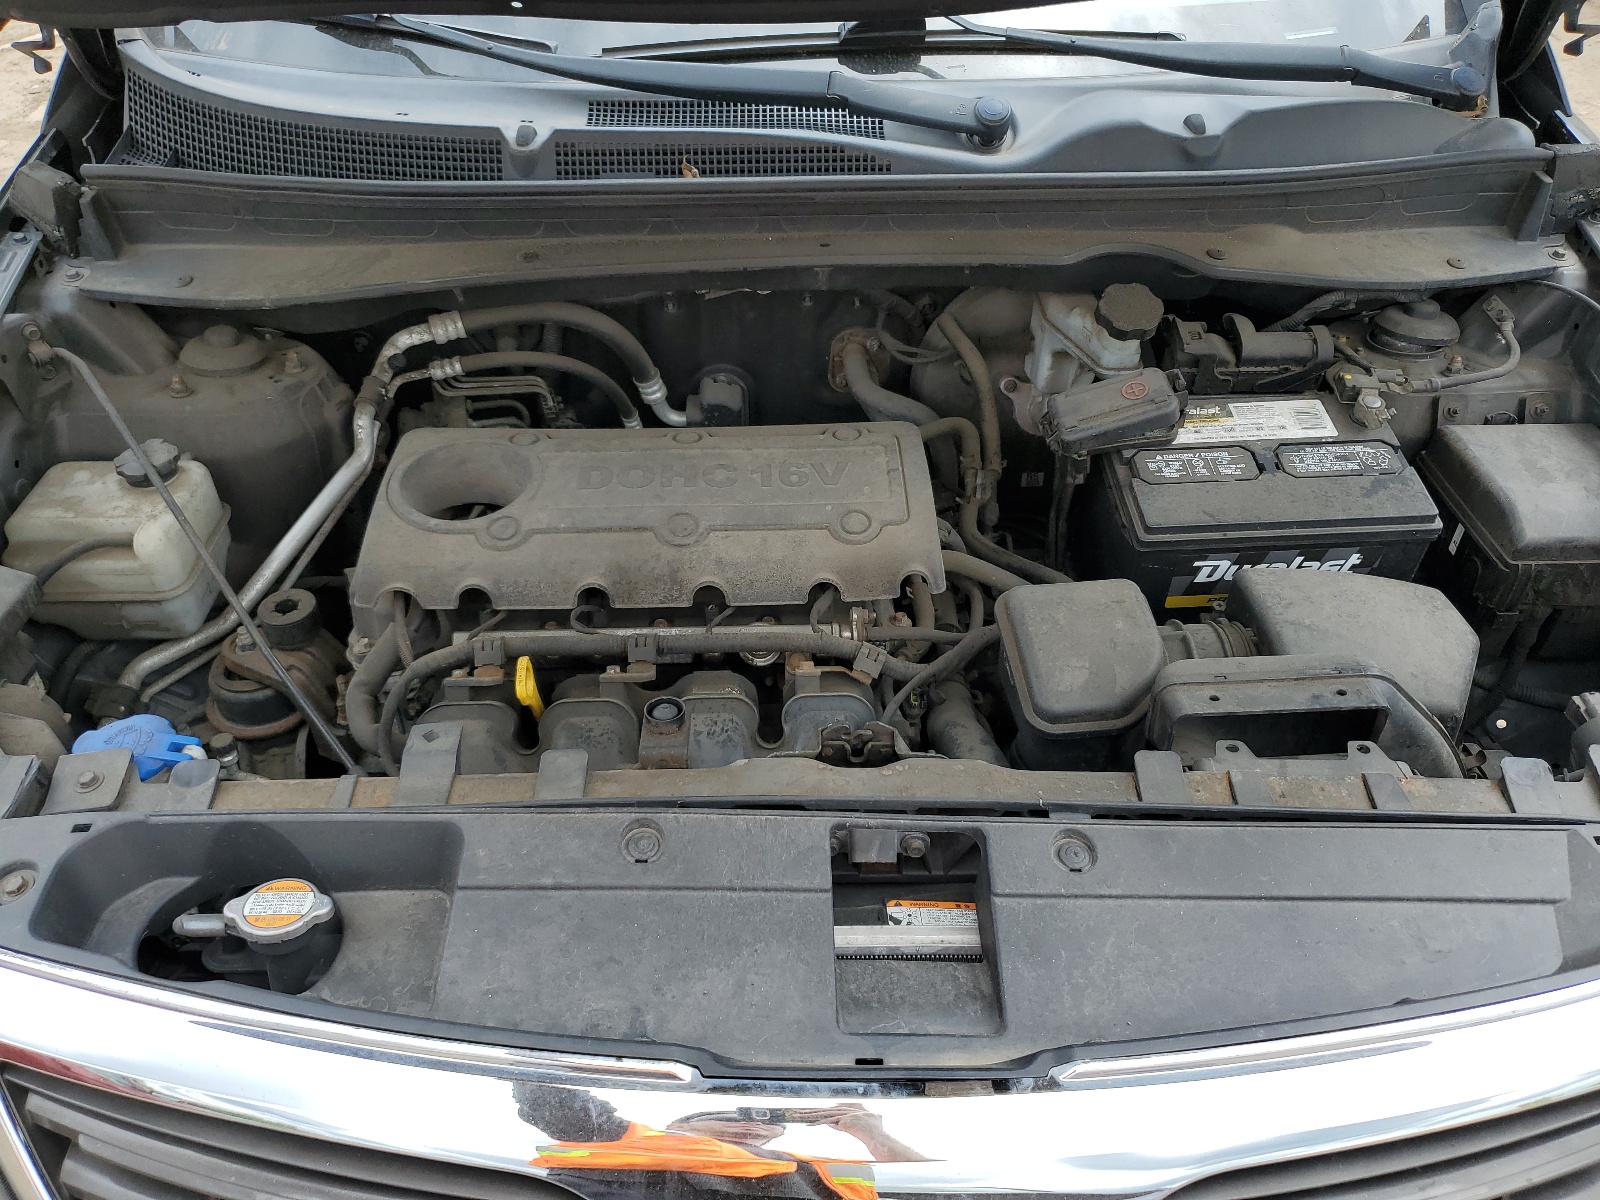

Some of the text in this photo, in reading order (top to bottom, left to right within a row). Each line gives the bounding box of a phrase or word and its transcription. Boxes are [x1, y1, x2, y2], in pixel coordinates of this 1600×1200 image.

[1184, 405, 1221, 416] alast
[576, 461, 849, 490] DOHC 16V
[1192, 553, 1363, 583] Dulst
